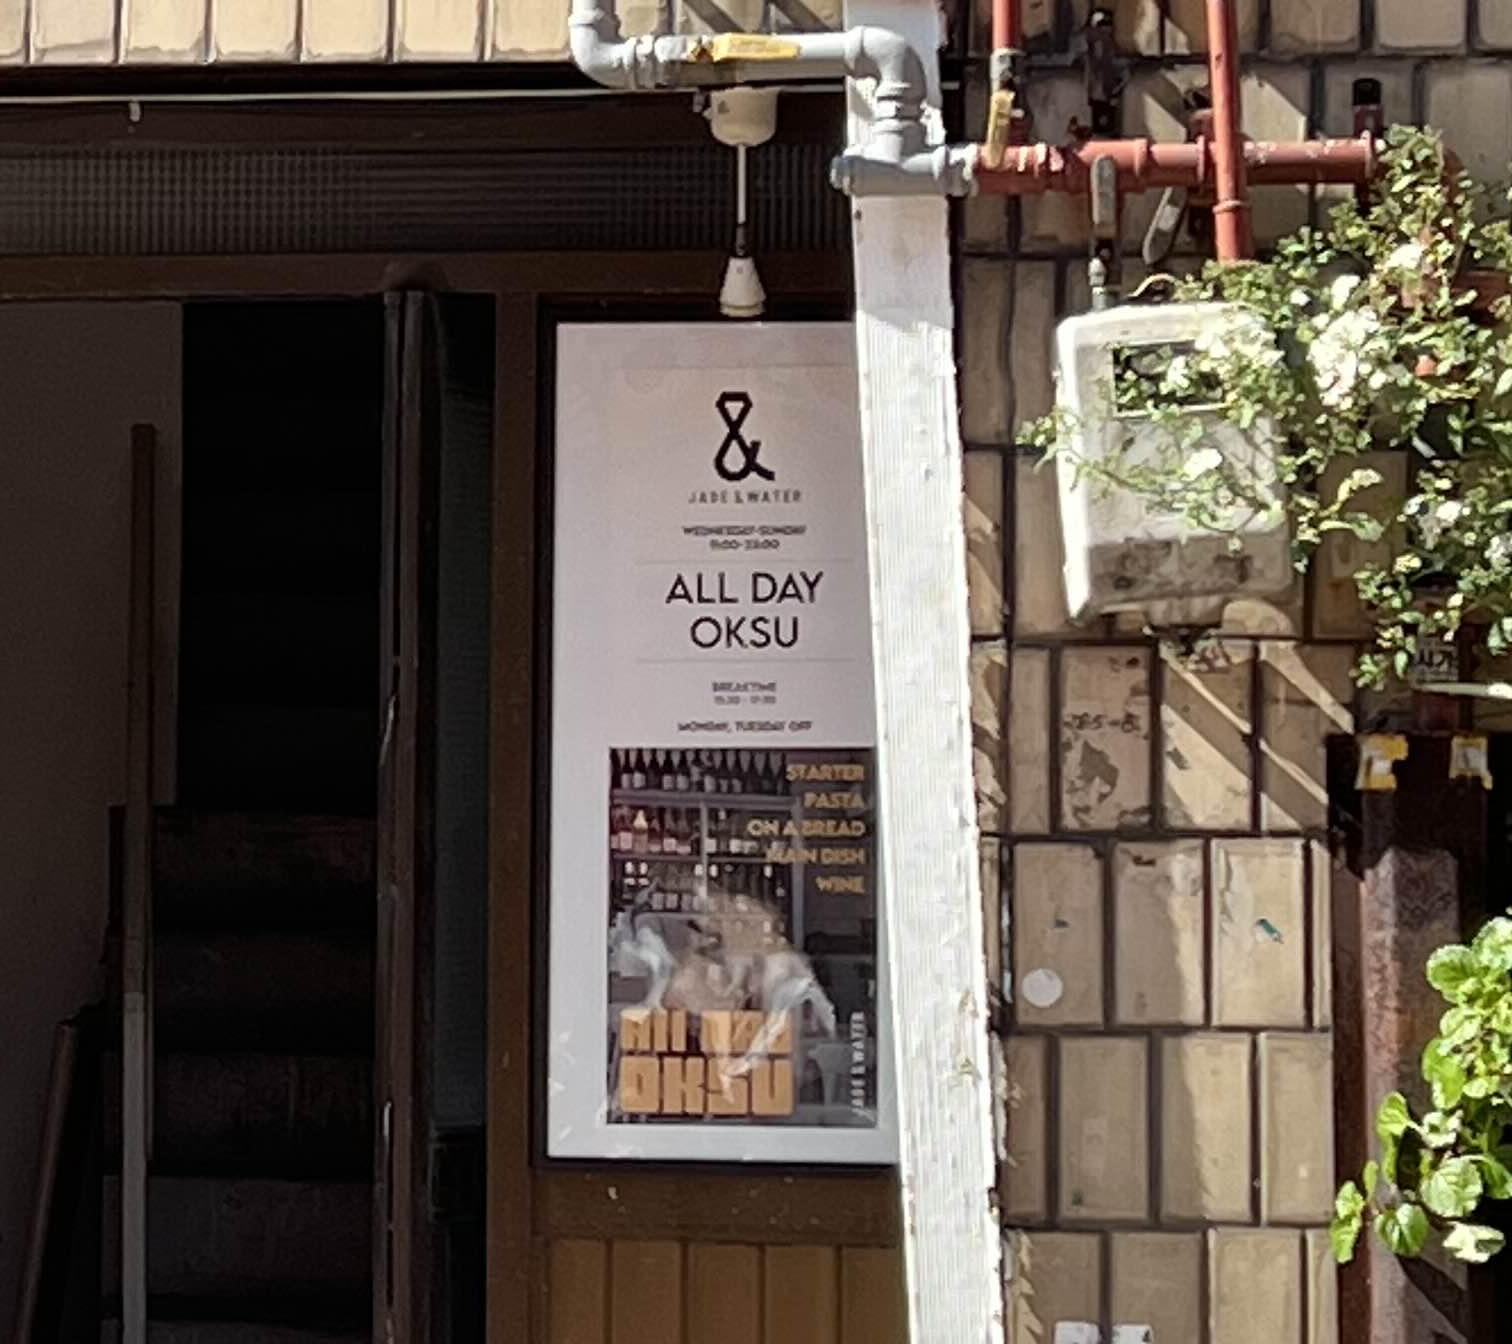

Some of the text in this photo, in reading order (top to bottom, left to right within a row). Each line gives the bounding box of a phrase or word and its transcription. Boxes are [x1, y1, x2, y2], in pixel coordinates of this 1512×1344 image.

[688, 490, 728, 505] JADE
[747, 490, 802, 504] WATER
[665, 571, 824, 605] ALL DAY
[690, 615, 800, 649] OKSU
[786, 764, 864, 781] STARTER
[803, 792, 865, 808] PASTA
[747, 819, 866, 836] ON A BREAD
[815, 875, 865, 894] WINE
[619, 1056, 793, 1115] OKSU
